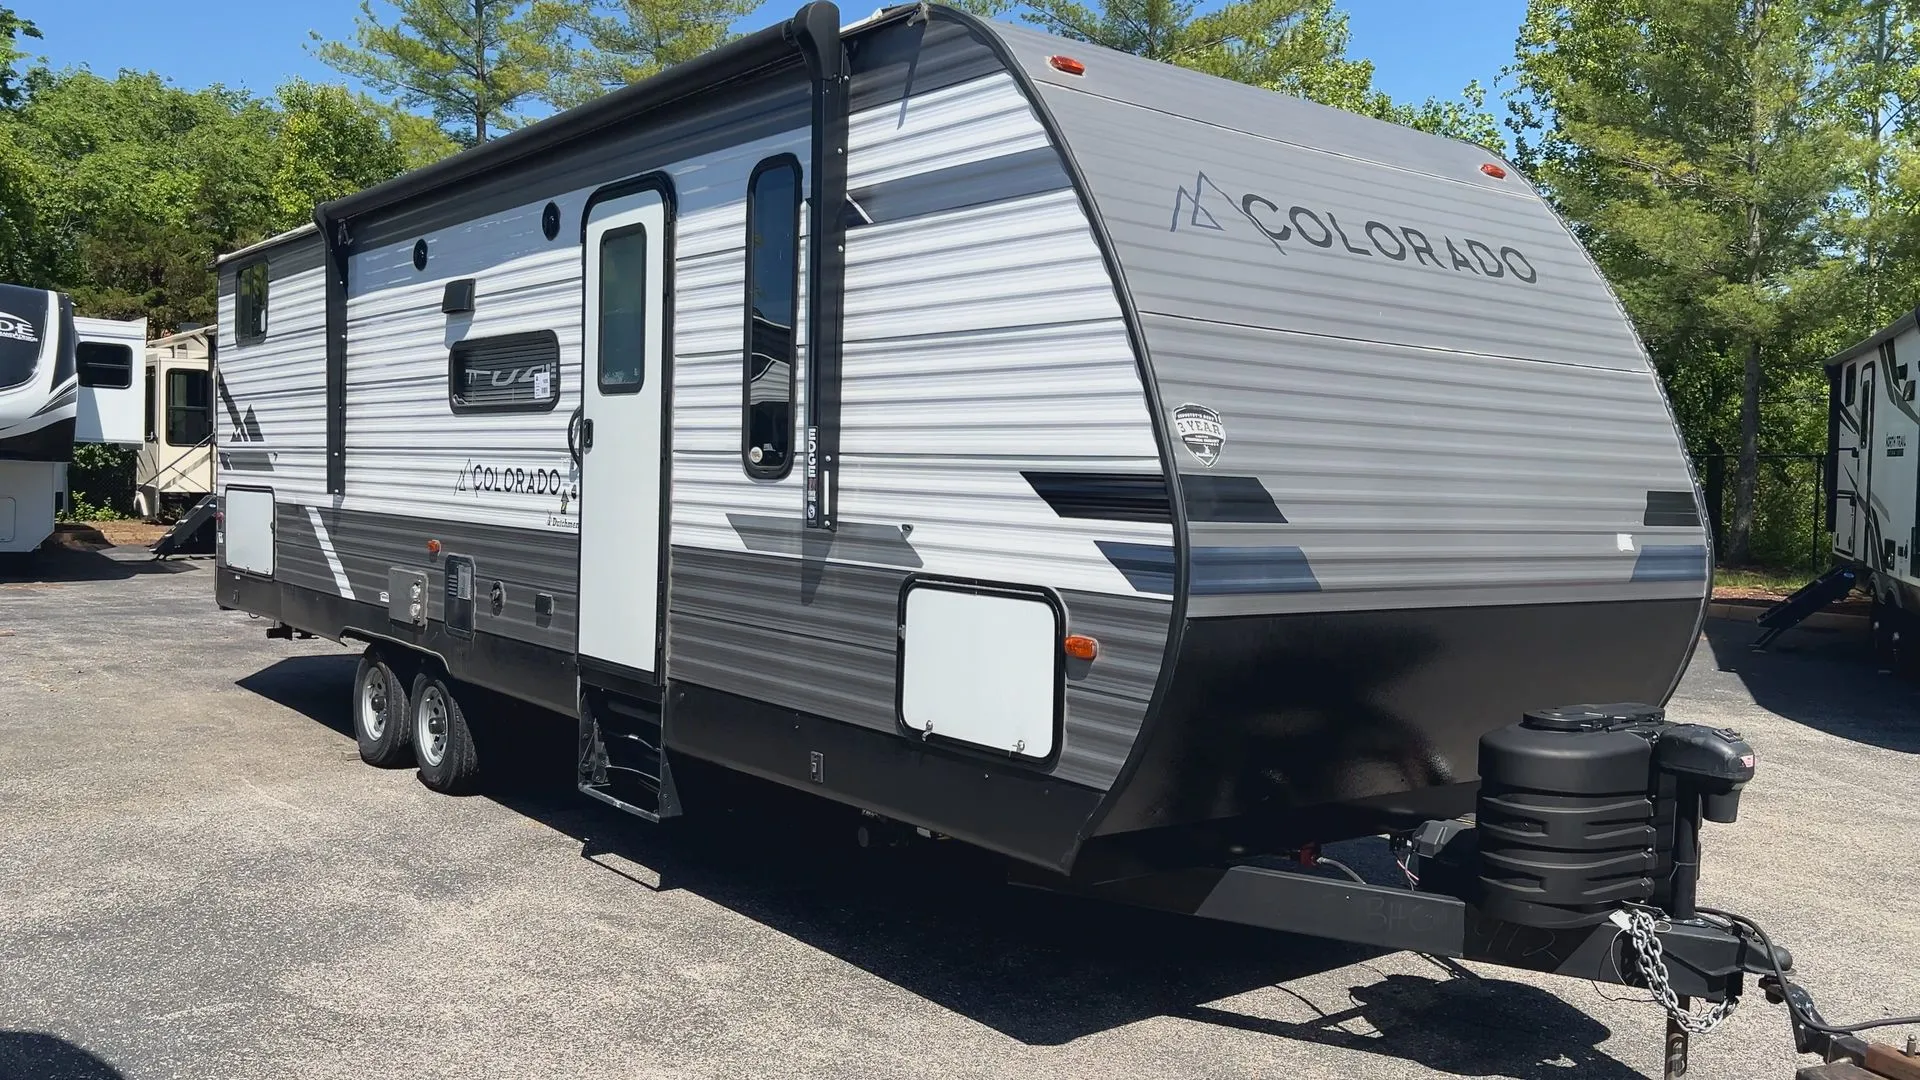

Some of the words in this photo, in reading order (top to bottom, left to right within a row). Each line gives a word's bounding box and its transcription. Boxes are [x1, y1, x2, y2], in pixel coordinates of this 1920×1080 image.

[1242, 193, 1537, 284] COLORADO
[1177, 422, 1186, 433] 3
[1186, 420, 1221, 435] YEAR
[807, 428, 817, 478] EDGE
[473, 464, 561, 495] COLORADO
